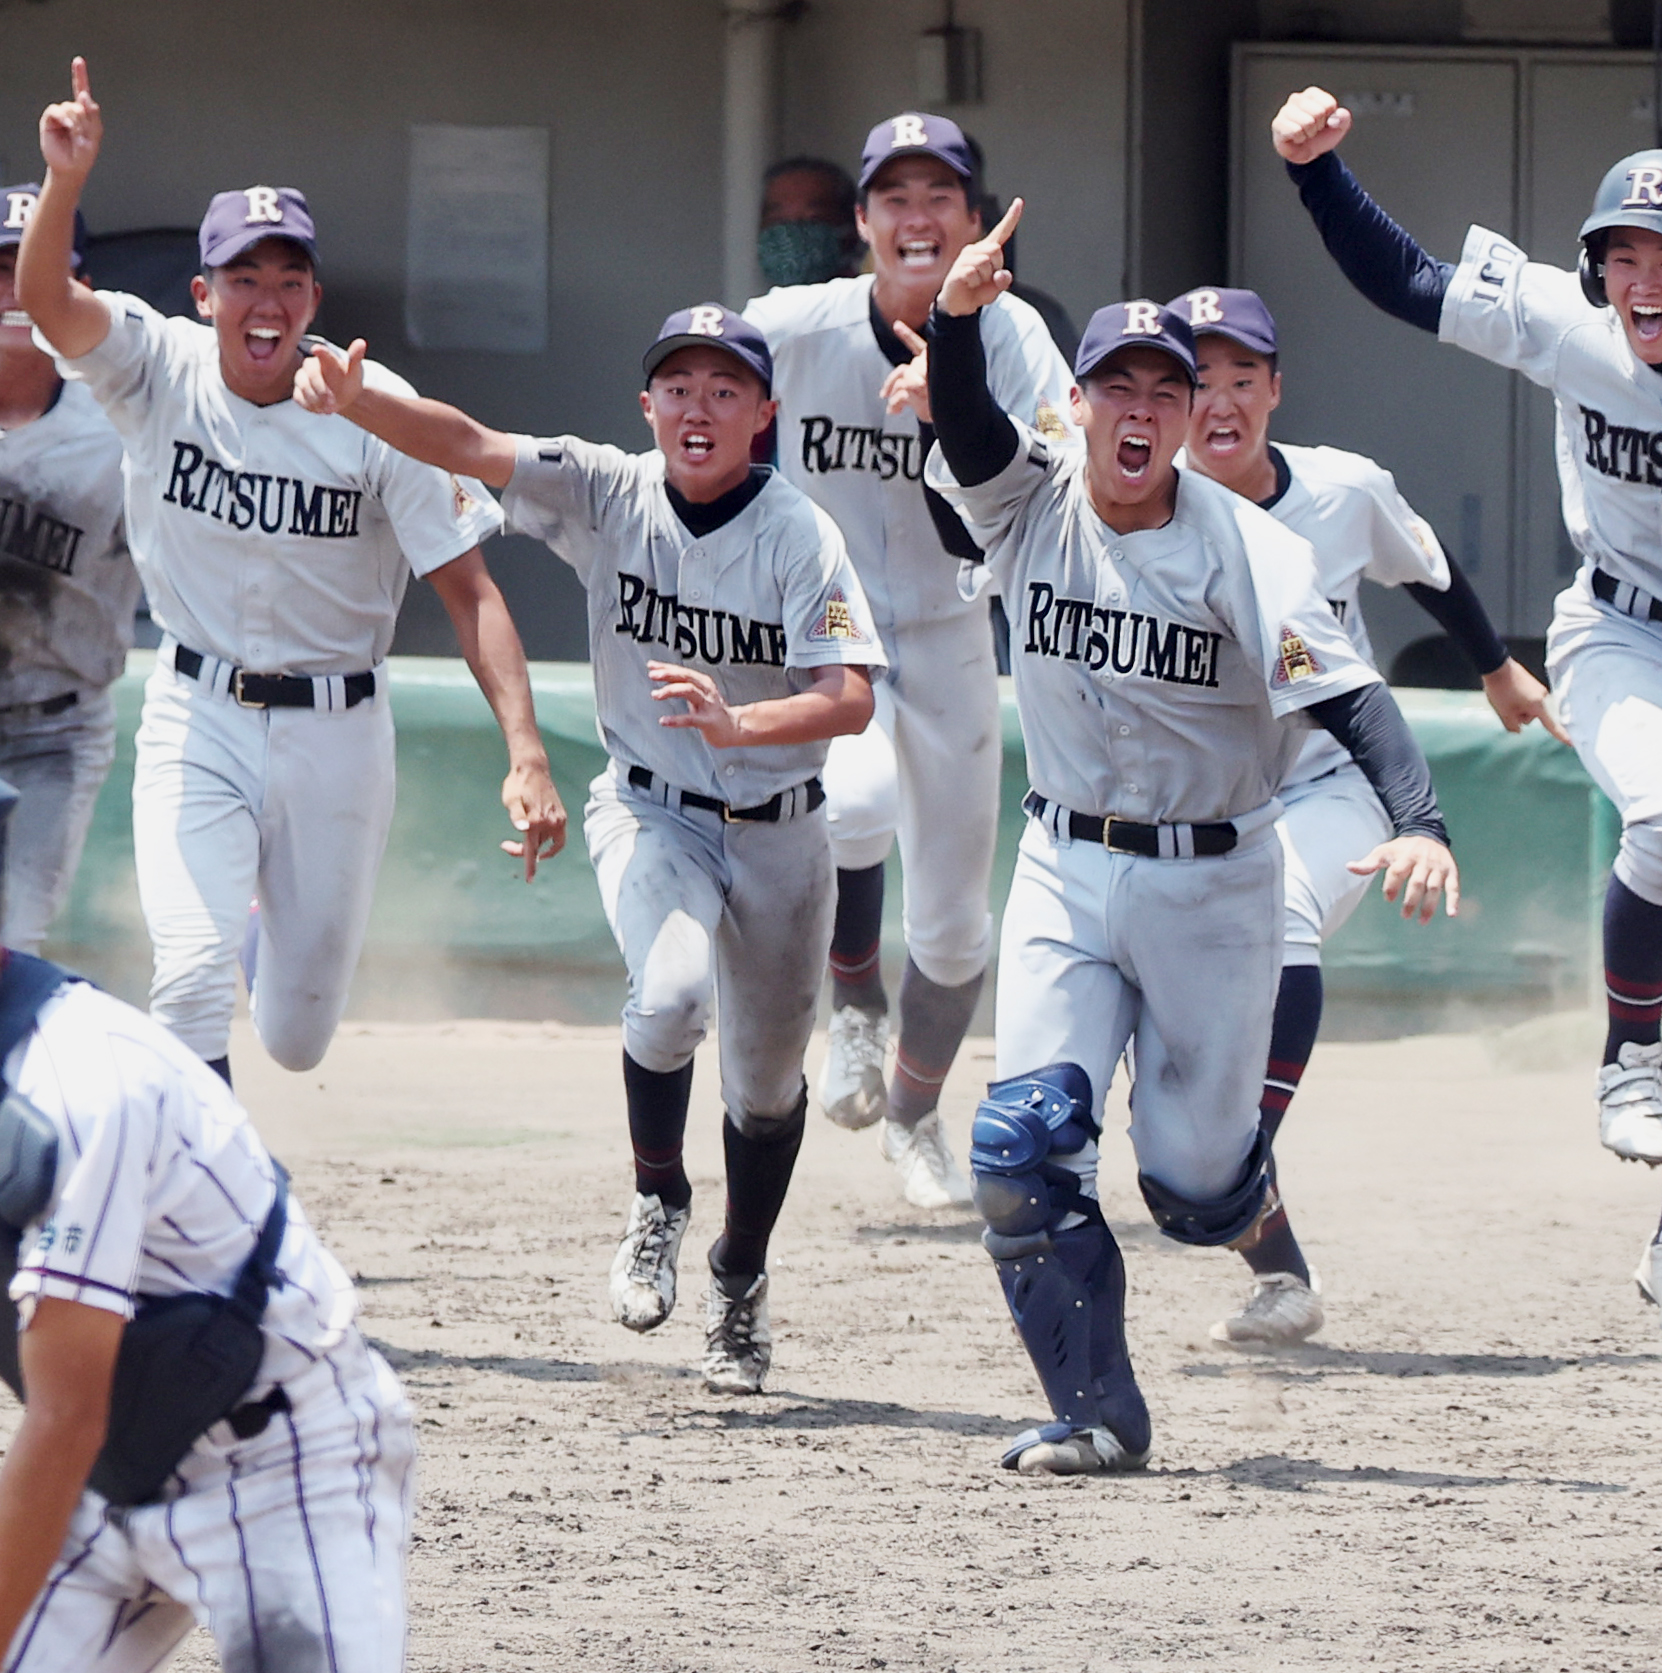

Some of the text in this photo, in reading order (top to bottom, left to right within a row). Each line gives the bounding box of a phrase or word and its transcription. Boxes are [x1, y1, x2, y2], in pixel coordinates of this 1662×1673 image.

[891, 115, 928, 149] R
[3, 193, 39, 228] R
[244, 186, 283, 222] R
[1472, 243, 1517, 304] UJI
[688, 306, 724, 336] R
[1122, 301, 1163, 336] R
[1187, 291, 1224, 327] R
[163, 440, 362, 538] RITSUMEI
[1025, 582, 1223, 688] RITSUMEI
